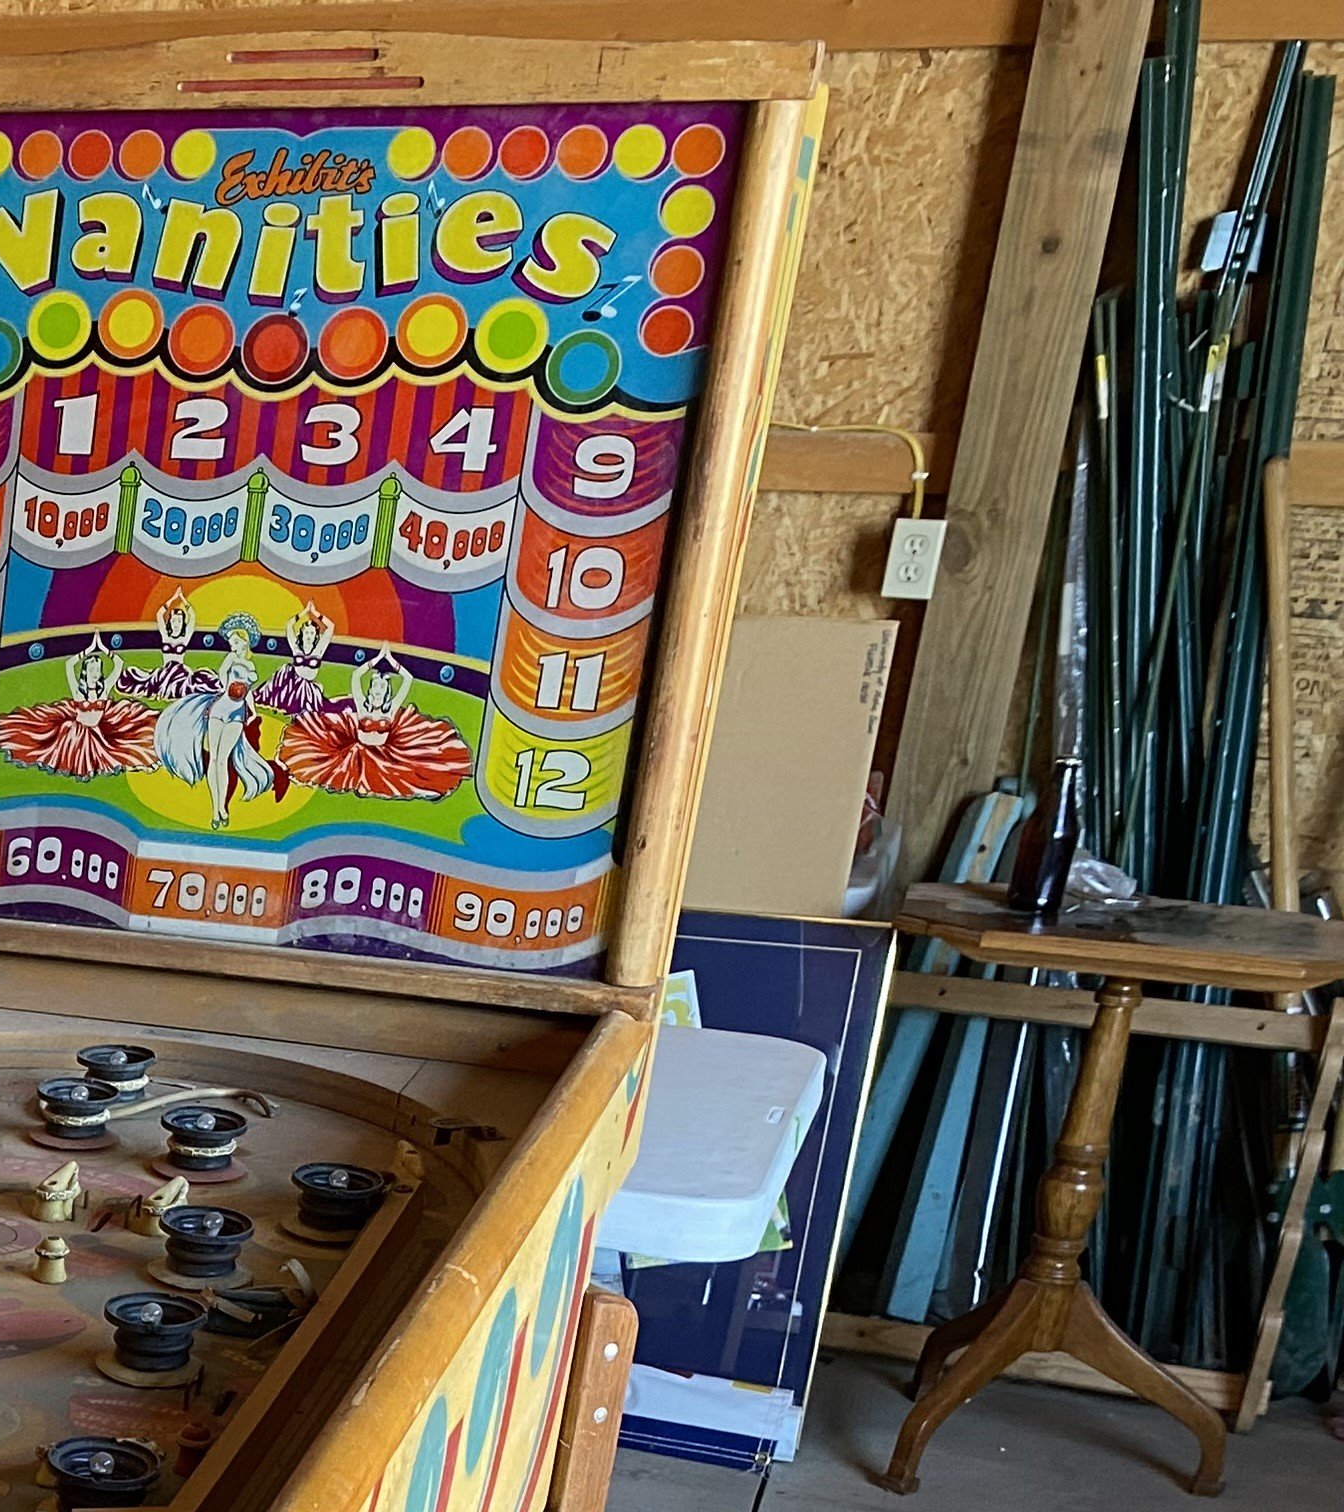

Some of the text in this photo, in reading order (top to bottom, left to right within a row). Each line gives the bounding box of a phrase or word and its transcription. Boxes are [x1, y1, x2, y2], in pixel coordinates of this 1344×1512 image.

[216, 148, 377, 206] Exhibit's
[53, 394, 100, 457] 1
[169, 397, 230, 461] 2
[300, 404, 362, 467] 3
[429, 404, 497, 475] 4
[573, 432, 639, 498] 9
[23, 499, 110, 550] 10,000
[141, 497, 240, 558] 20,000
[268, 503, 372, 565] 30,000
[397, 501, 506, 572] 40,000
[544, 542, 627, 612] 10
[535, 651, 609, 714] 11
[514, 749, 594, 812] 12
[5, 835, 120, 892] 60,000
[146, 867, 269, 920] 70,000
[299, 865, 425, 921] 80,000
[453, 890, 586, 944] 90,000
